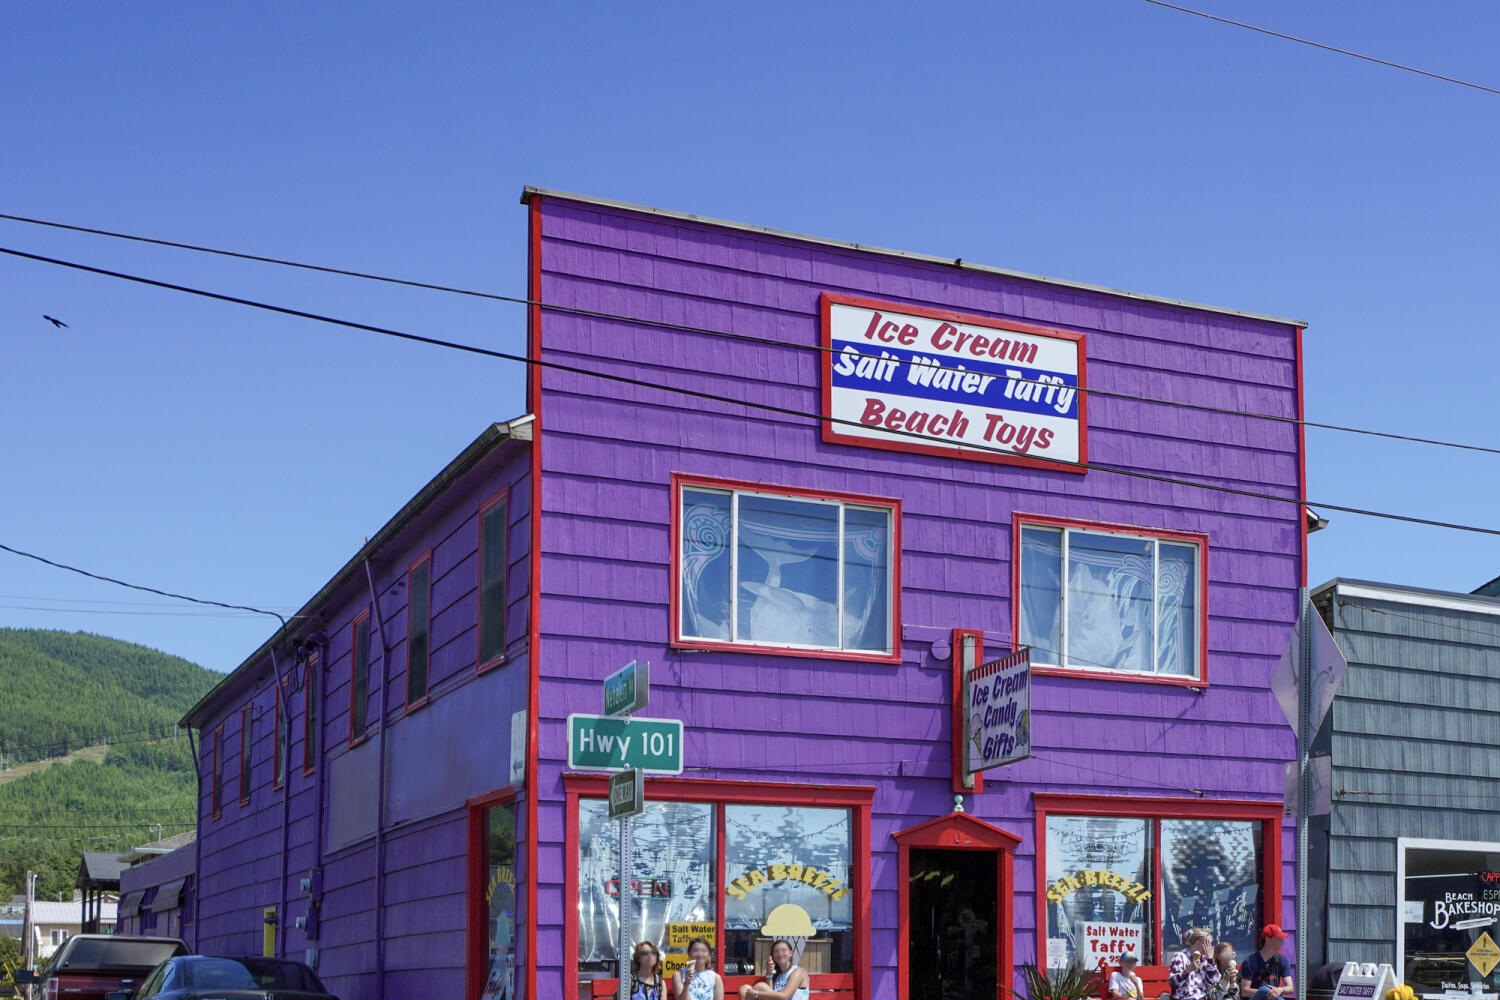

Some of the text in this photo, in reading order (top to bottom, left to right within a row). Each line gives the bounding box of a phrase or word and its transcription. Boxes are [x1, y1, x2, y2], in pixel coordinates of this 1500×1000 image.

[864, 312, 1039, 364] Ice Cream
[833, 346, 1076, 414] Salt Water Taffy
[859, 398, 1055, 454] Beach Toys
[972, 669, 1028, 707] Ice Cream
[984, 697, 1017, 728] Candy
[580, 728, 673, 760] Hwy 101
[983, 733, 1015, 760] Gifts
[613, 783, 632, 804] ONE WAY
[606, 880, 670, 898] OPEN
[726, 864, 851, 901] SEA BREEZE
[1047, 870, 1152, 904] SEA BREEZE
[1446, 892, 1473, 903] BEACH
[672, 925, 716, 933] Salt Water
[1086, 925, 1139, 937] Salt Water
[1090, 939, 1136, 953] Taffy
[1339, 985, 1374, 996] SALT WATER TAFFY
